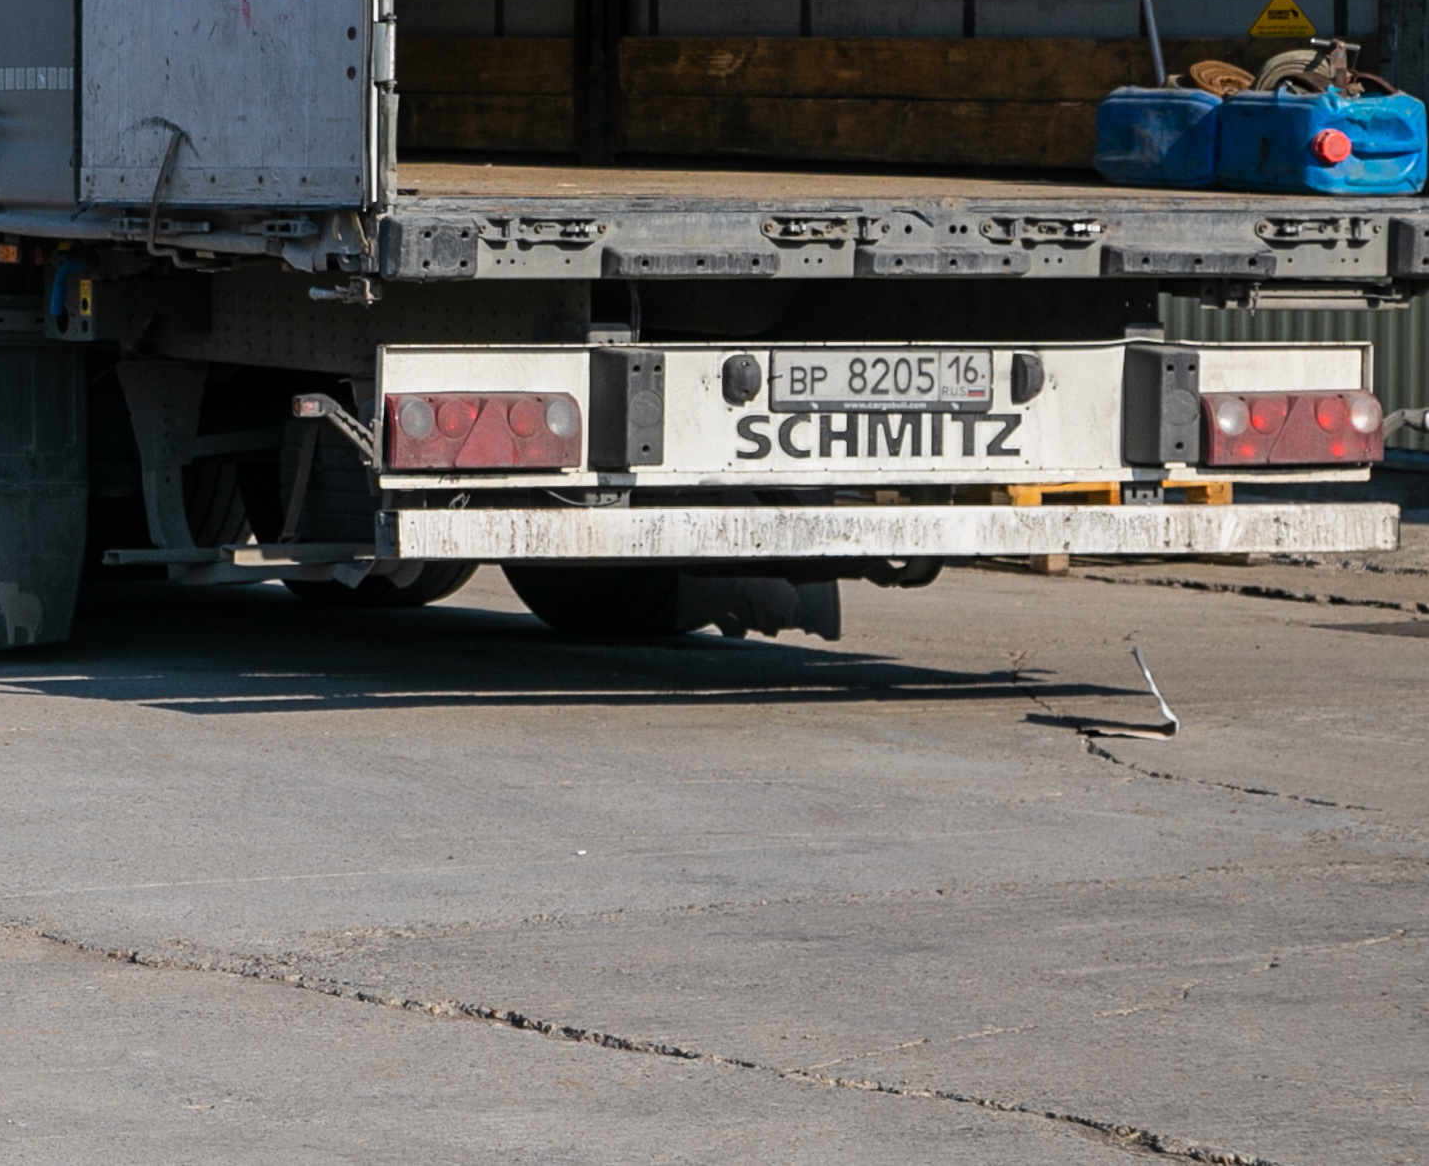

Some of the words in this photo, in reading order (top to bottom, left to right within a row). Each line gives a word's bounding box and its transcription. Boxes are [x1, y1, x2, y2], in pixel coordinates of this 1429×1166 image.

[847, 357, 936, 396] 8205
[947, 355, 979, 384] 16
[941, 386, 967, 397] RUS
[843, 401, 928, 411] www.cargobull.com
[736, 413, 1023, 460] SCHMITZ
